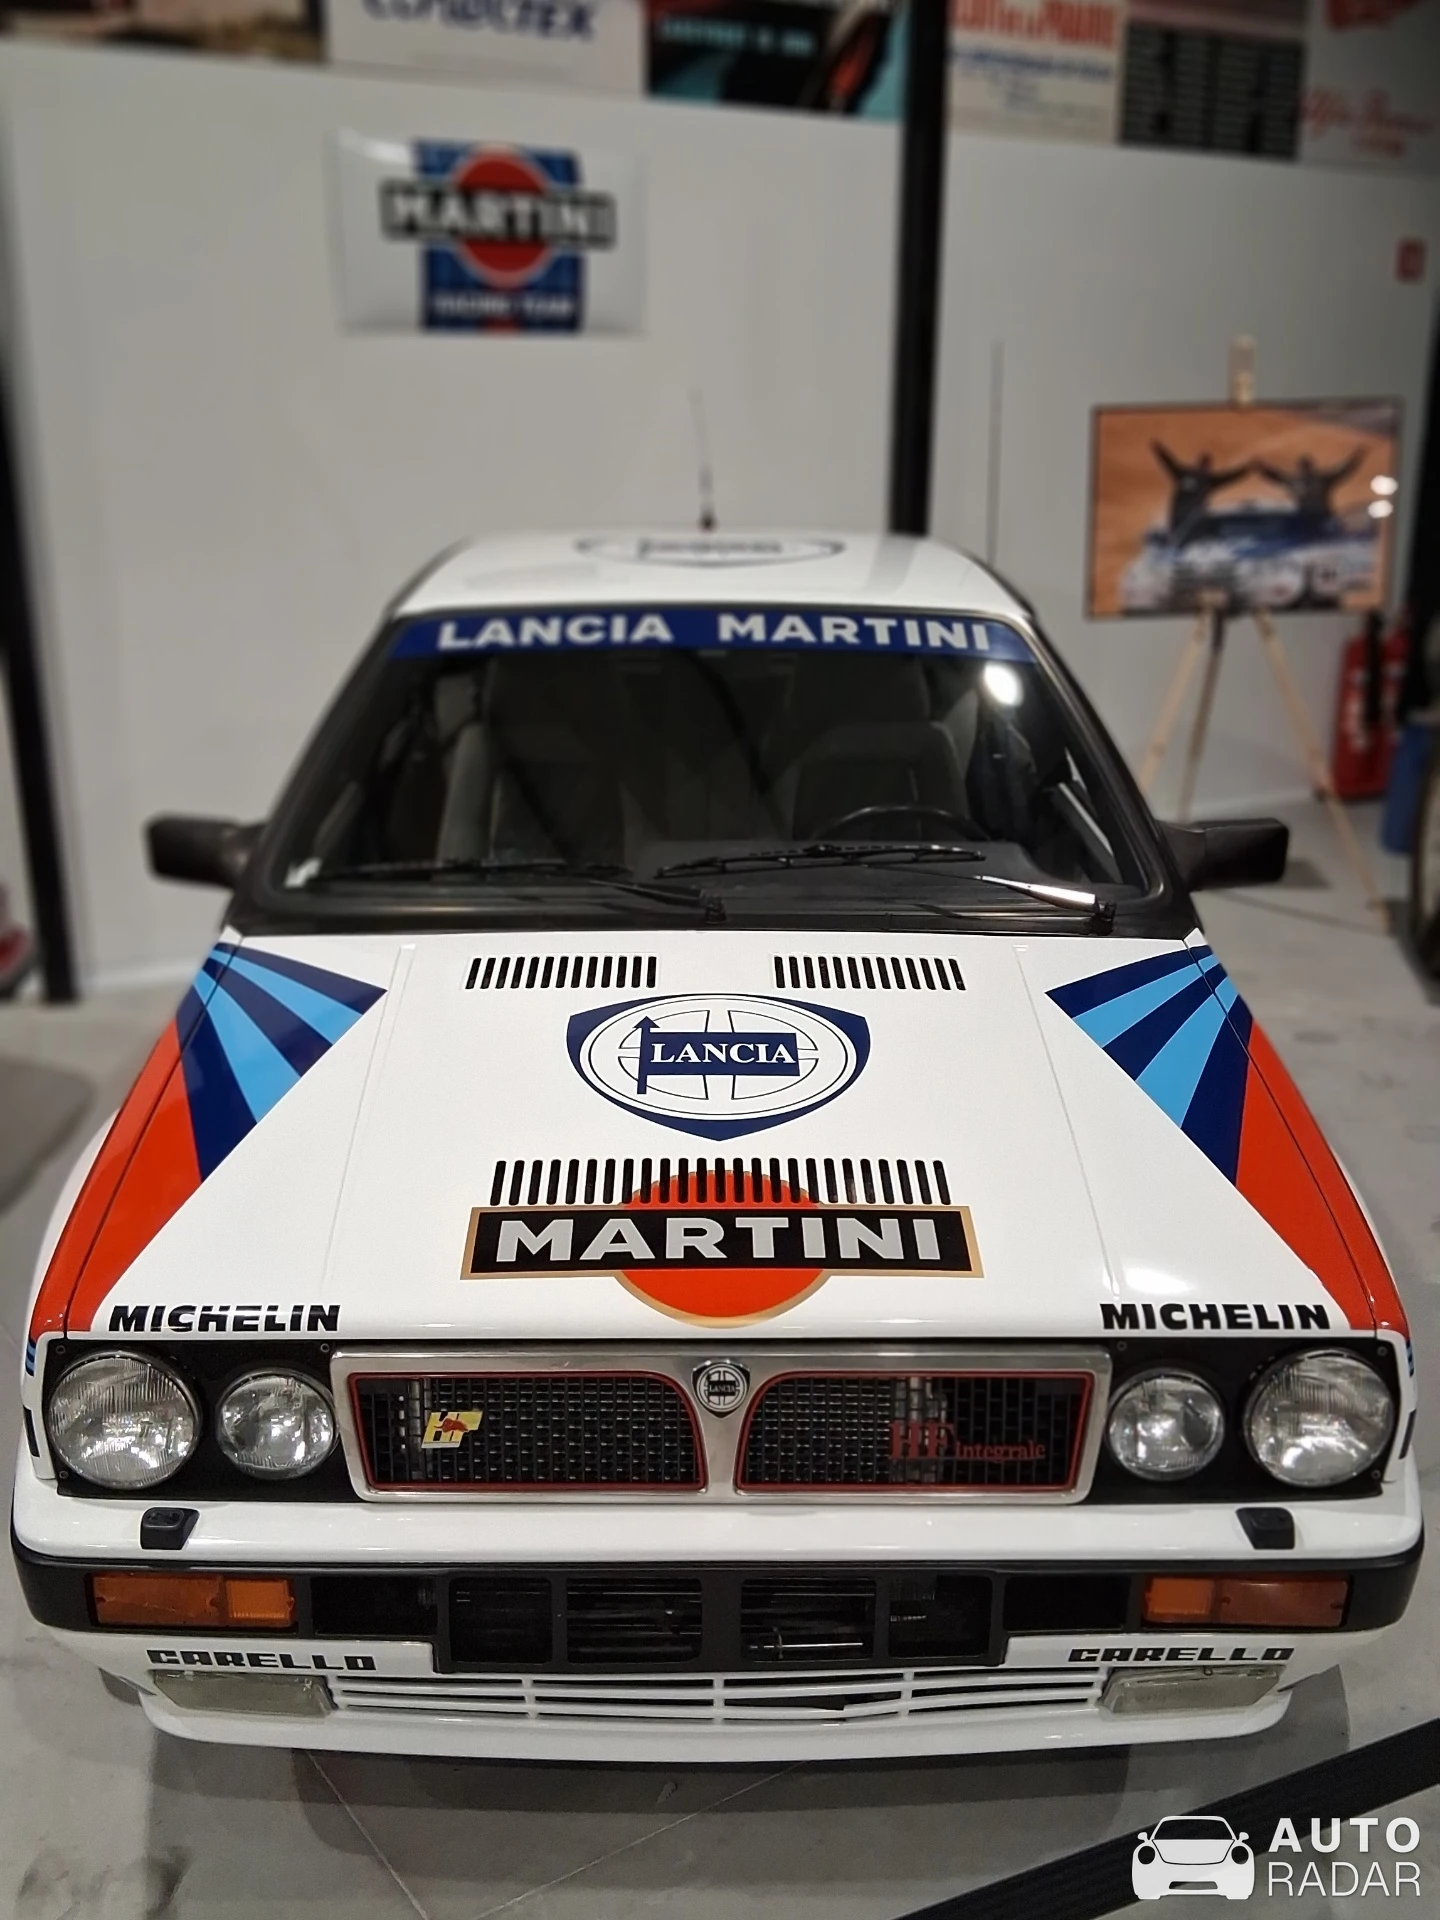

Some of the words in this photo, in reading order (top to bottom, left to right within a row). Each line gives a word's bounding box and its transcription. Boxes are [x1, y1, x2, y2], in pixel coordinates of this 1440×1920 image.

[388, 194, 610, 240] MARTINI
[438, 614, 673, 650] LANCIA
[717, 615, 989, 650] MARTINI
[651, 1043, 796, 1063] LANCIA
[496, 1217, 941, 1263] MARTINI
[108, 1304, 340, 1333] MICHELIN
[1100, 1303, 1331, 1330] MICHELIN
[709, 1384, 735, 1393] LANCIA
[889, 1420, 955, 1459] HF
[147, 1649, 376, 1671] CARELLO
[1068, 1647, 1295, 1663] CARELLO
